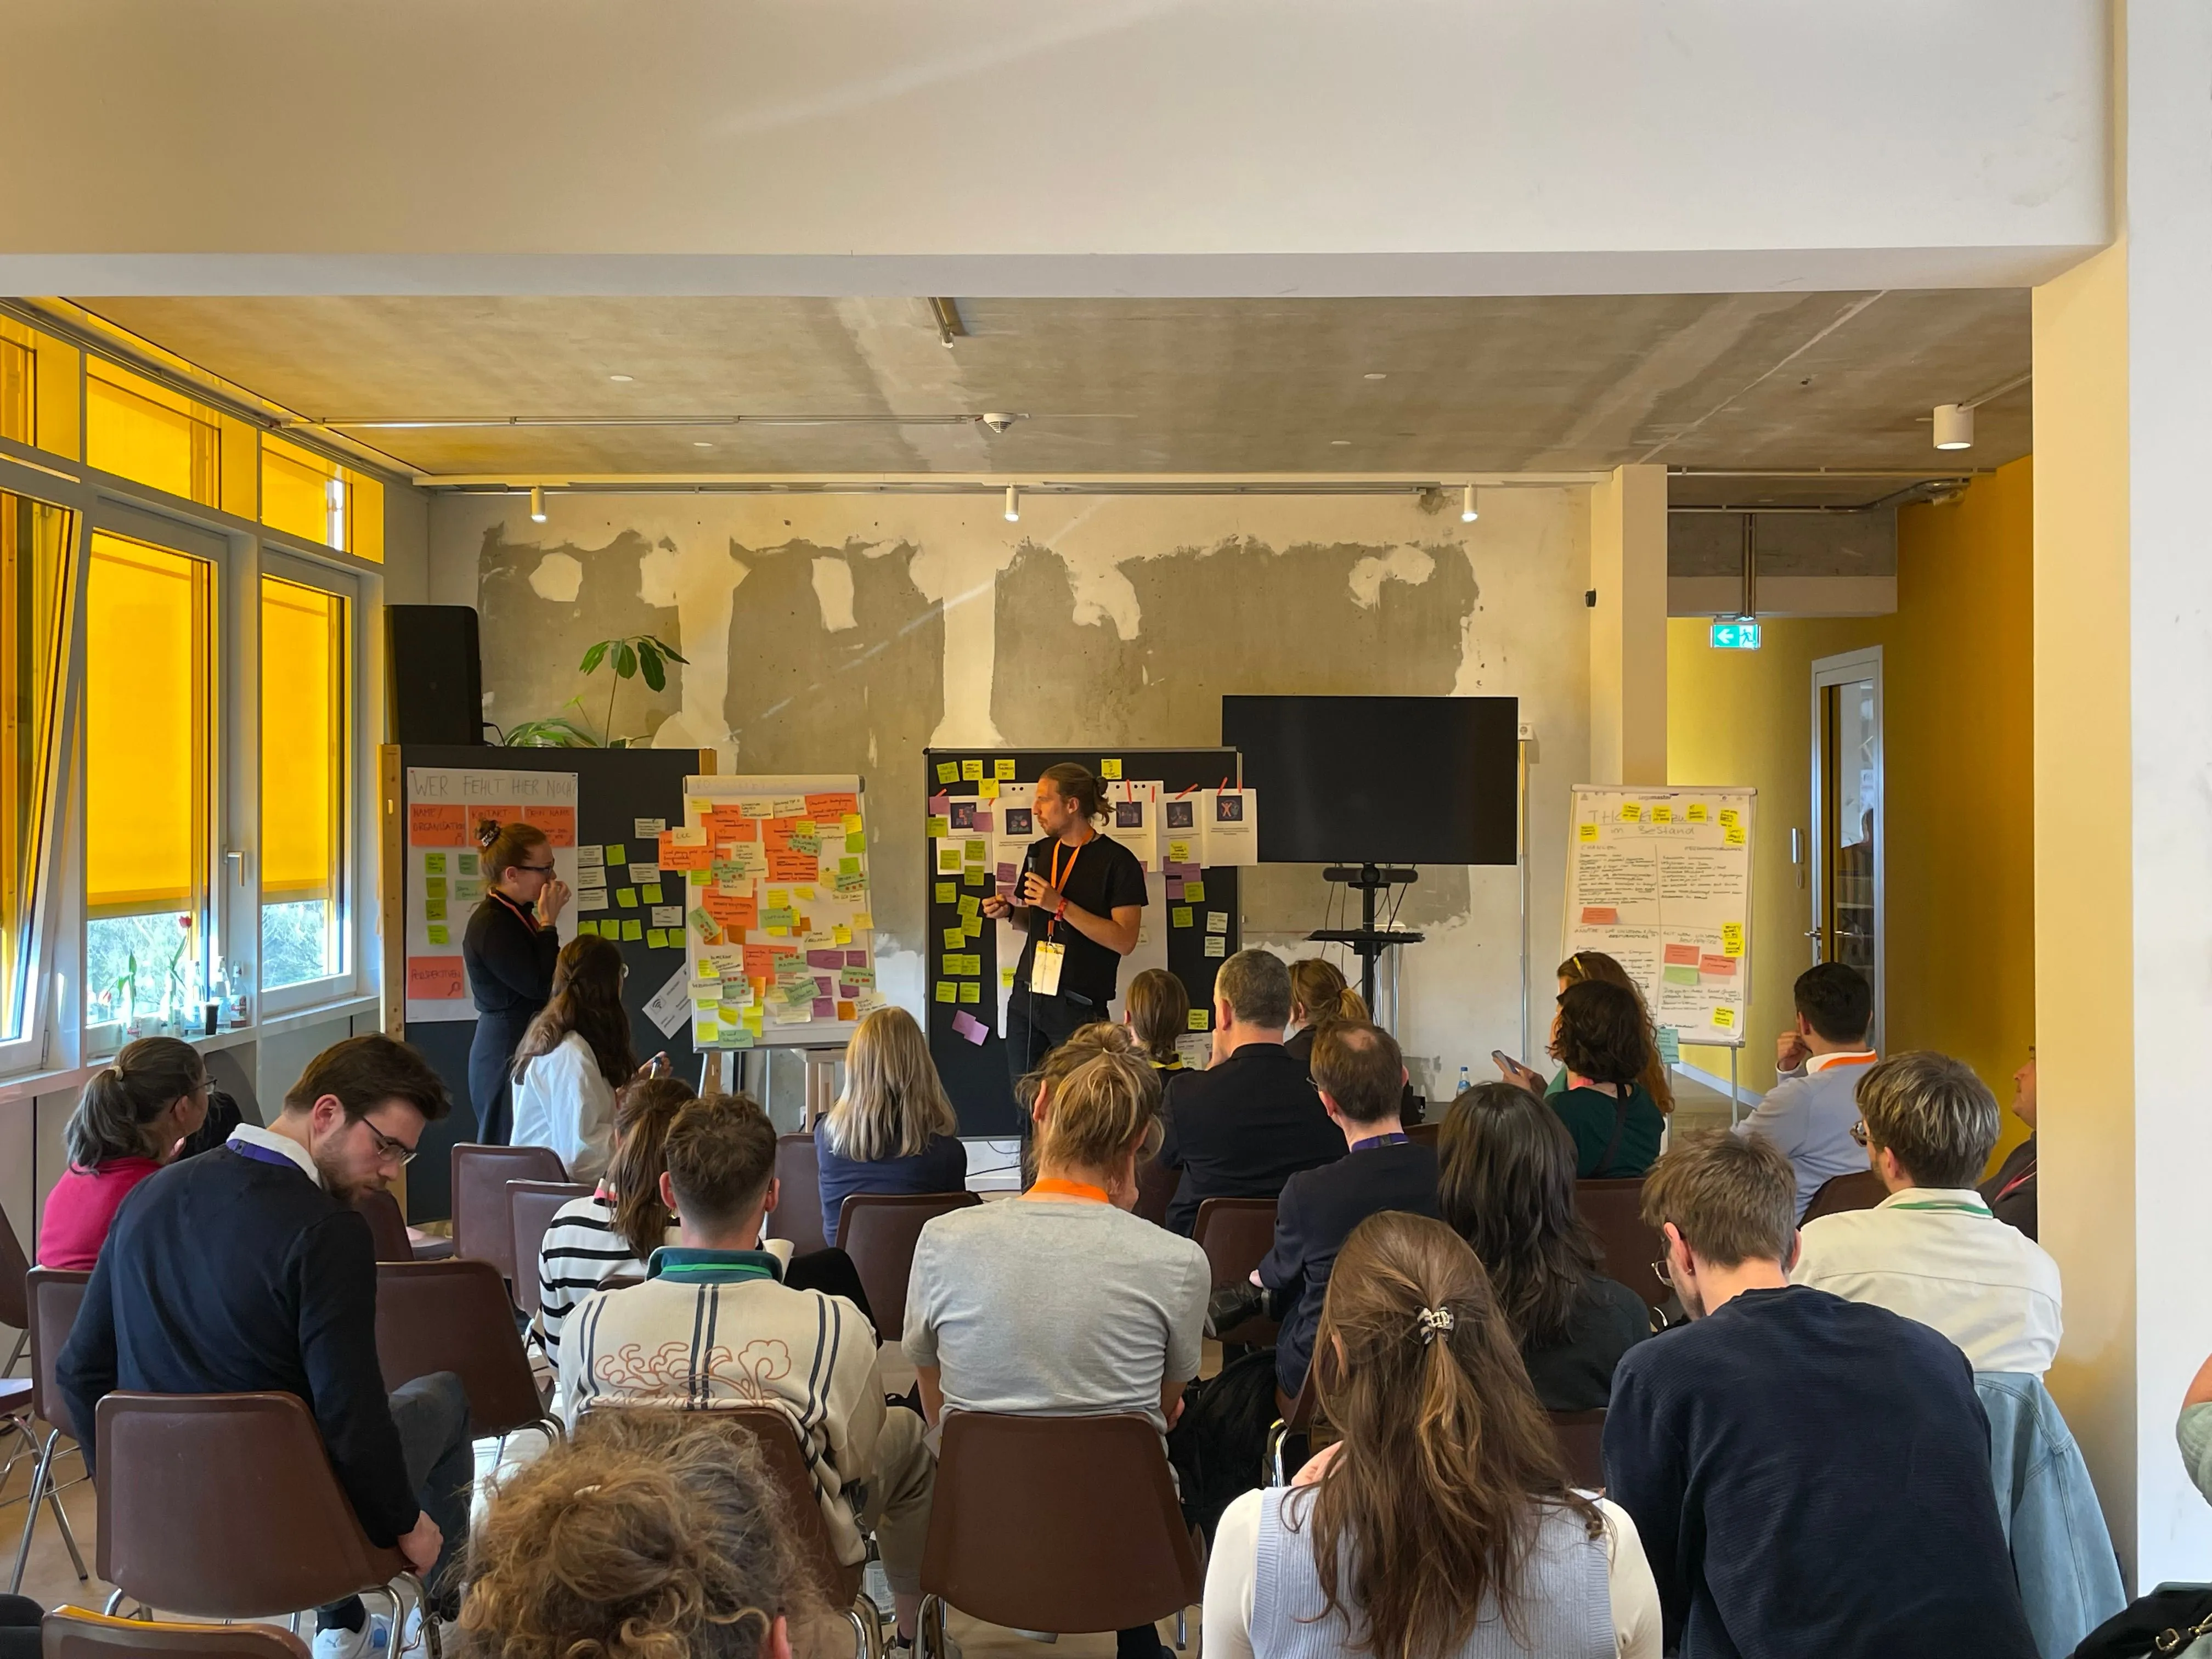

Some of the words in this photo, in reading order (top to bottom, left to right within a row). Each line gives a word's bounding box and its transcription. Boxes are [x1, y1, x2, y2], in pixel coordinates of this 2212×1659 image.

[413, 774, 448, 797] WER
[463, 775, 505, 796] FEHLT
[512, 777, 539, 795] HIER
[547, 778, 578, 798] NOCH?
